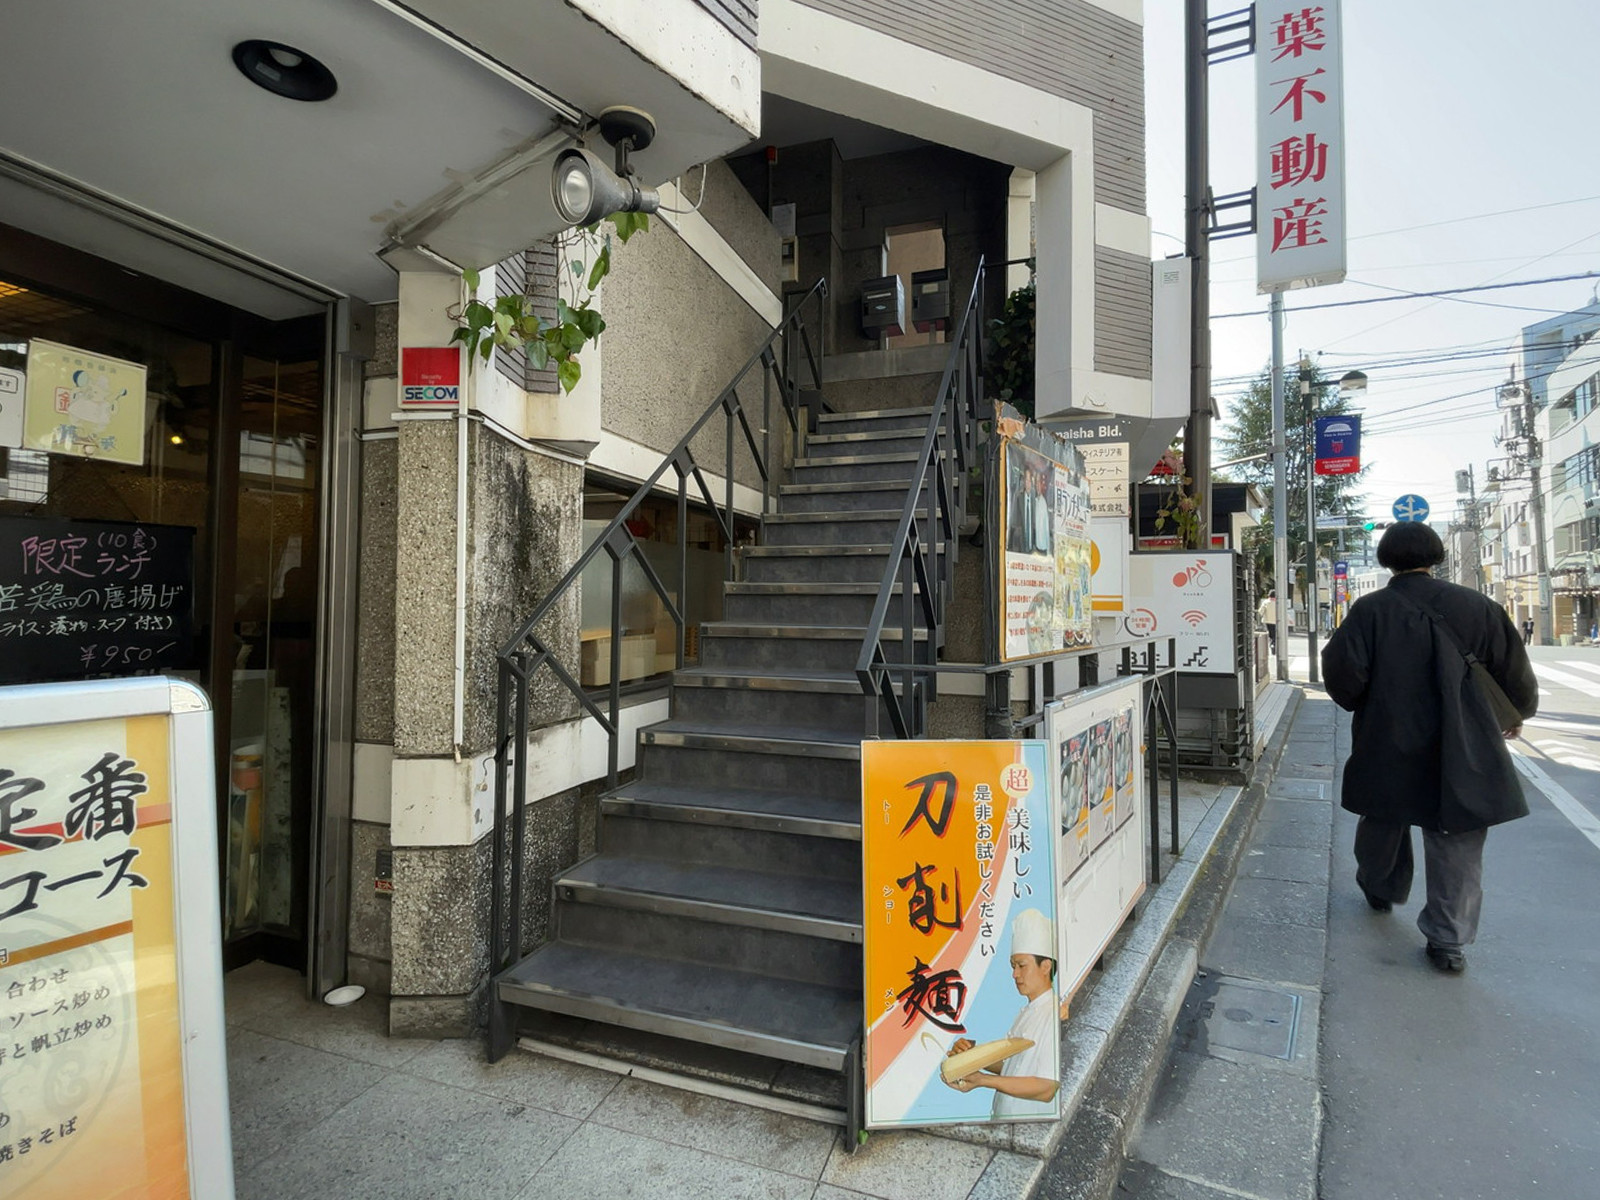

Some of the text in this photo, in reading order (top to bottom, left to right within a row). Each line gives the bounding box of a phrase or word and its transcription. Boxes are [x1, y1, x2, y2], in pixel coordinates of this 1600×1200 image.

[1270, 7, 1329, 254] 葉不動産
[405, 387, 458, 400] SECOM
[1099, 425, 1122, 437] Bld.
[21, 534, 152, 580] 限定 ランチ
[0, 752, 147, 851] 定番
[1006, 768, 1032, 898] 超 美味しい
[0, 849, 148, 921] コース
[897, 771, 968, 1034] 刀削麺
[974, 785, 996, 956] 是非お試しください
[6, 968, 69, 1000] 合わせ
[10, 986, 110, 1029] ソース炒め
